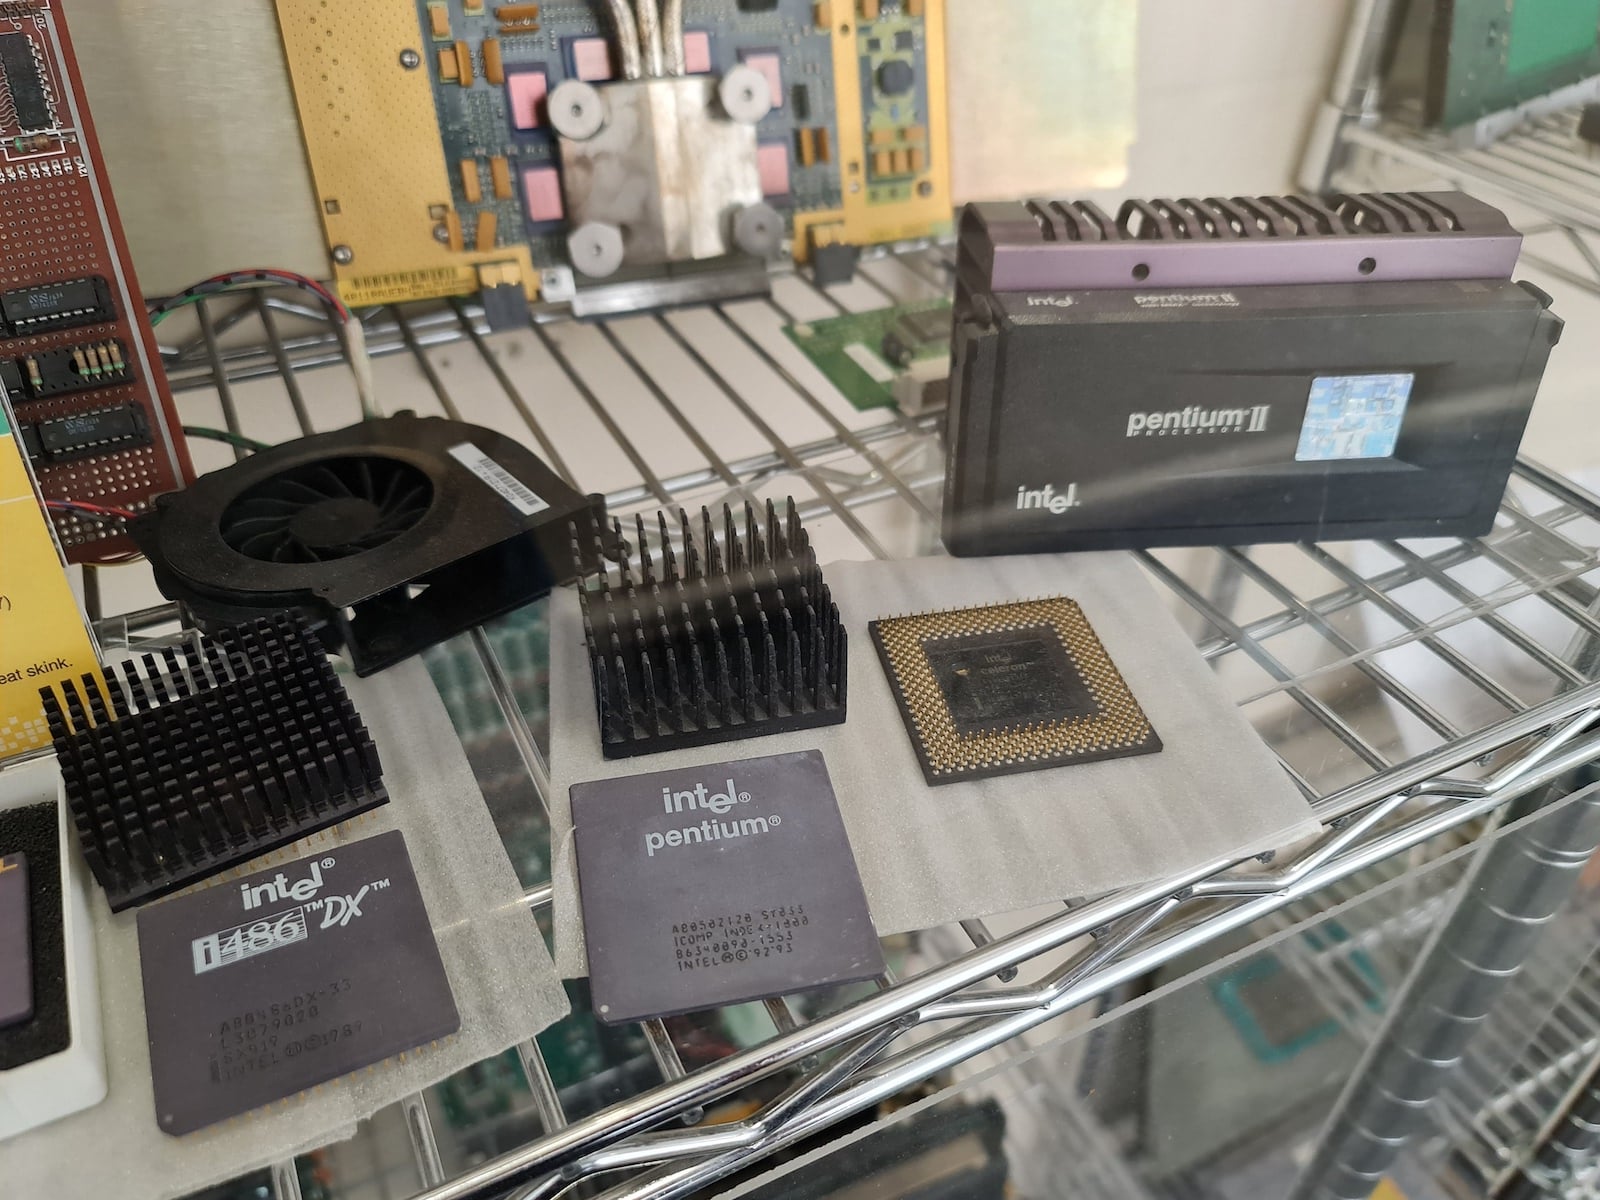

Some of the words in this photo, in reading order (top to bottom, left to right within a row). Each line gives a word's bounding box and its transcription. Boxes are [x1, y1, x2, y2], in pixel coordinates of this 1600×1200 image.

[1126, 405, 1244, 437] pentium
[1245, 404, 1271, 432] II
[26, 657, 73, 677] skink.
